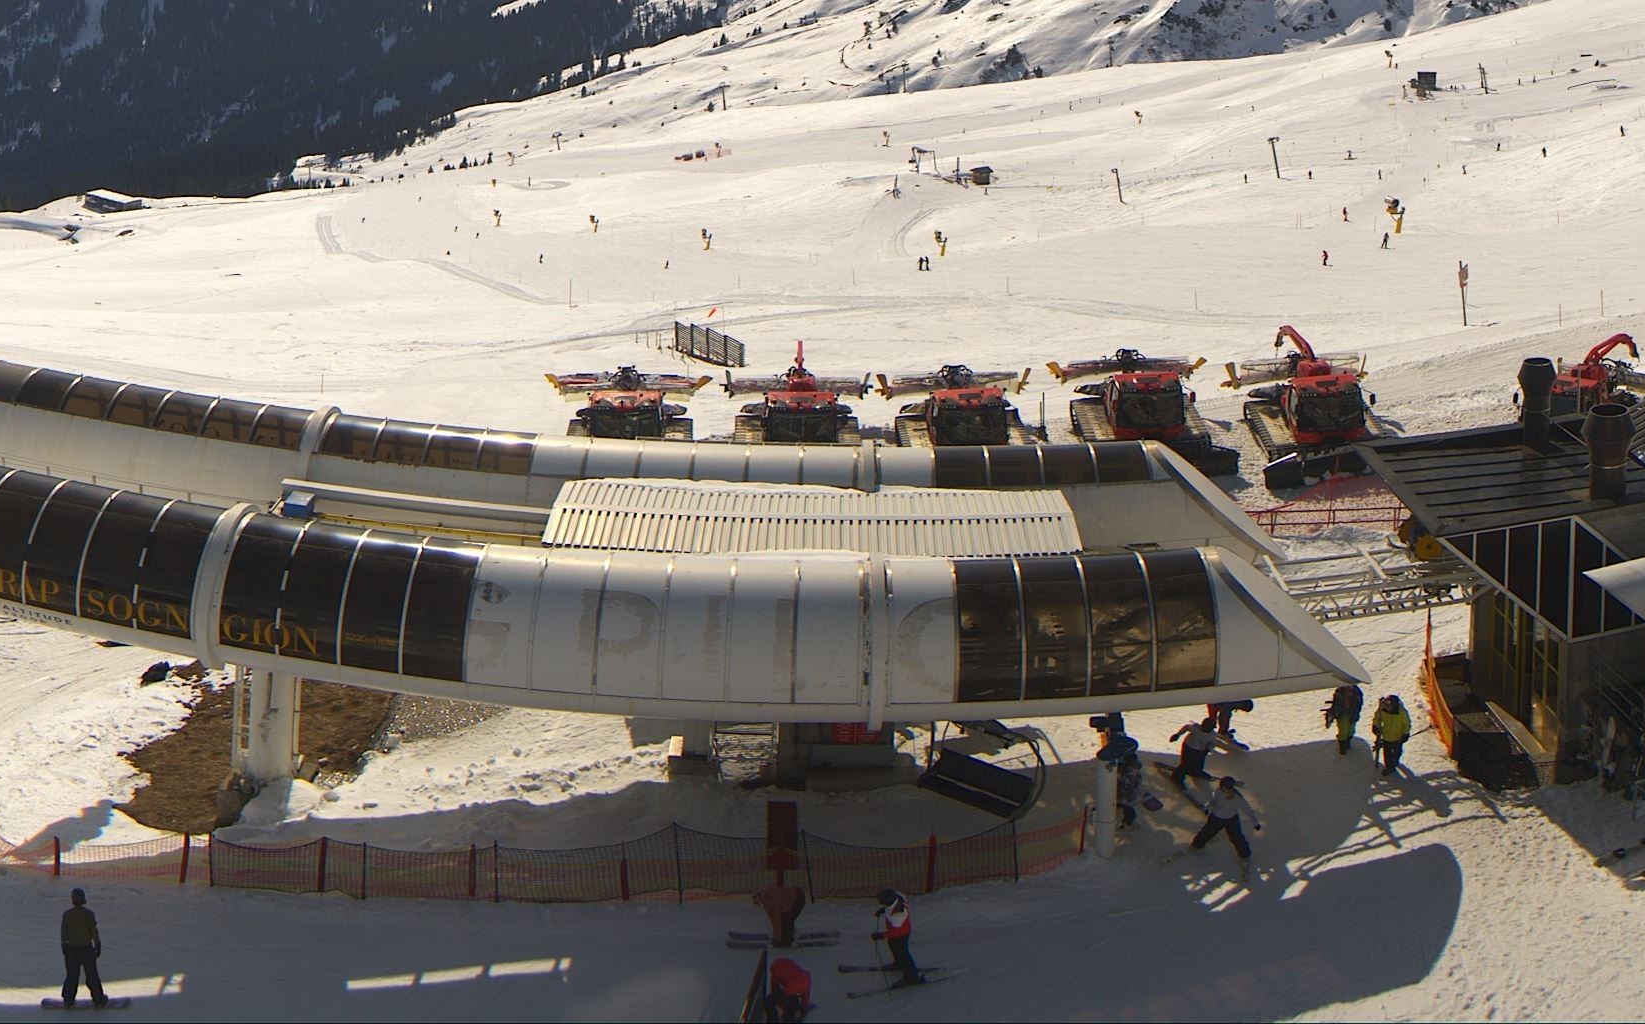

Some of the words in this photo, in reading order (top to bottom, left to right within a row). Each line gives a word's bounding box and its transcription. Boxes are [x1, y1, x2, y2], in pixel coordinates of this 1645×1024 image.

[2, 604, 74, 626] ALTITUDE
[86, 589, 191, 633] SOGN
[222, 614, 318, 656] GION
